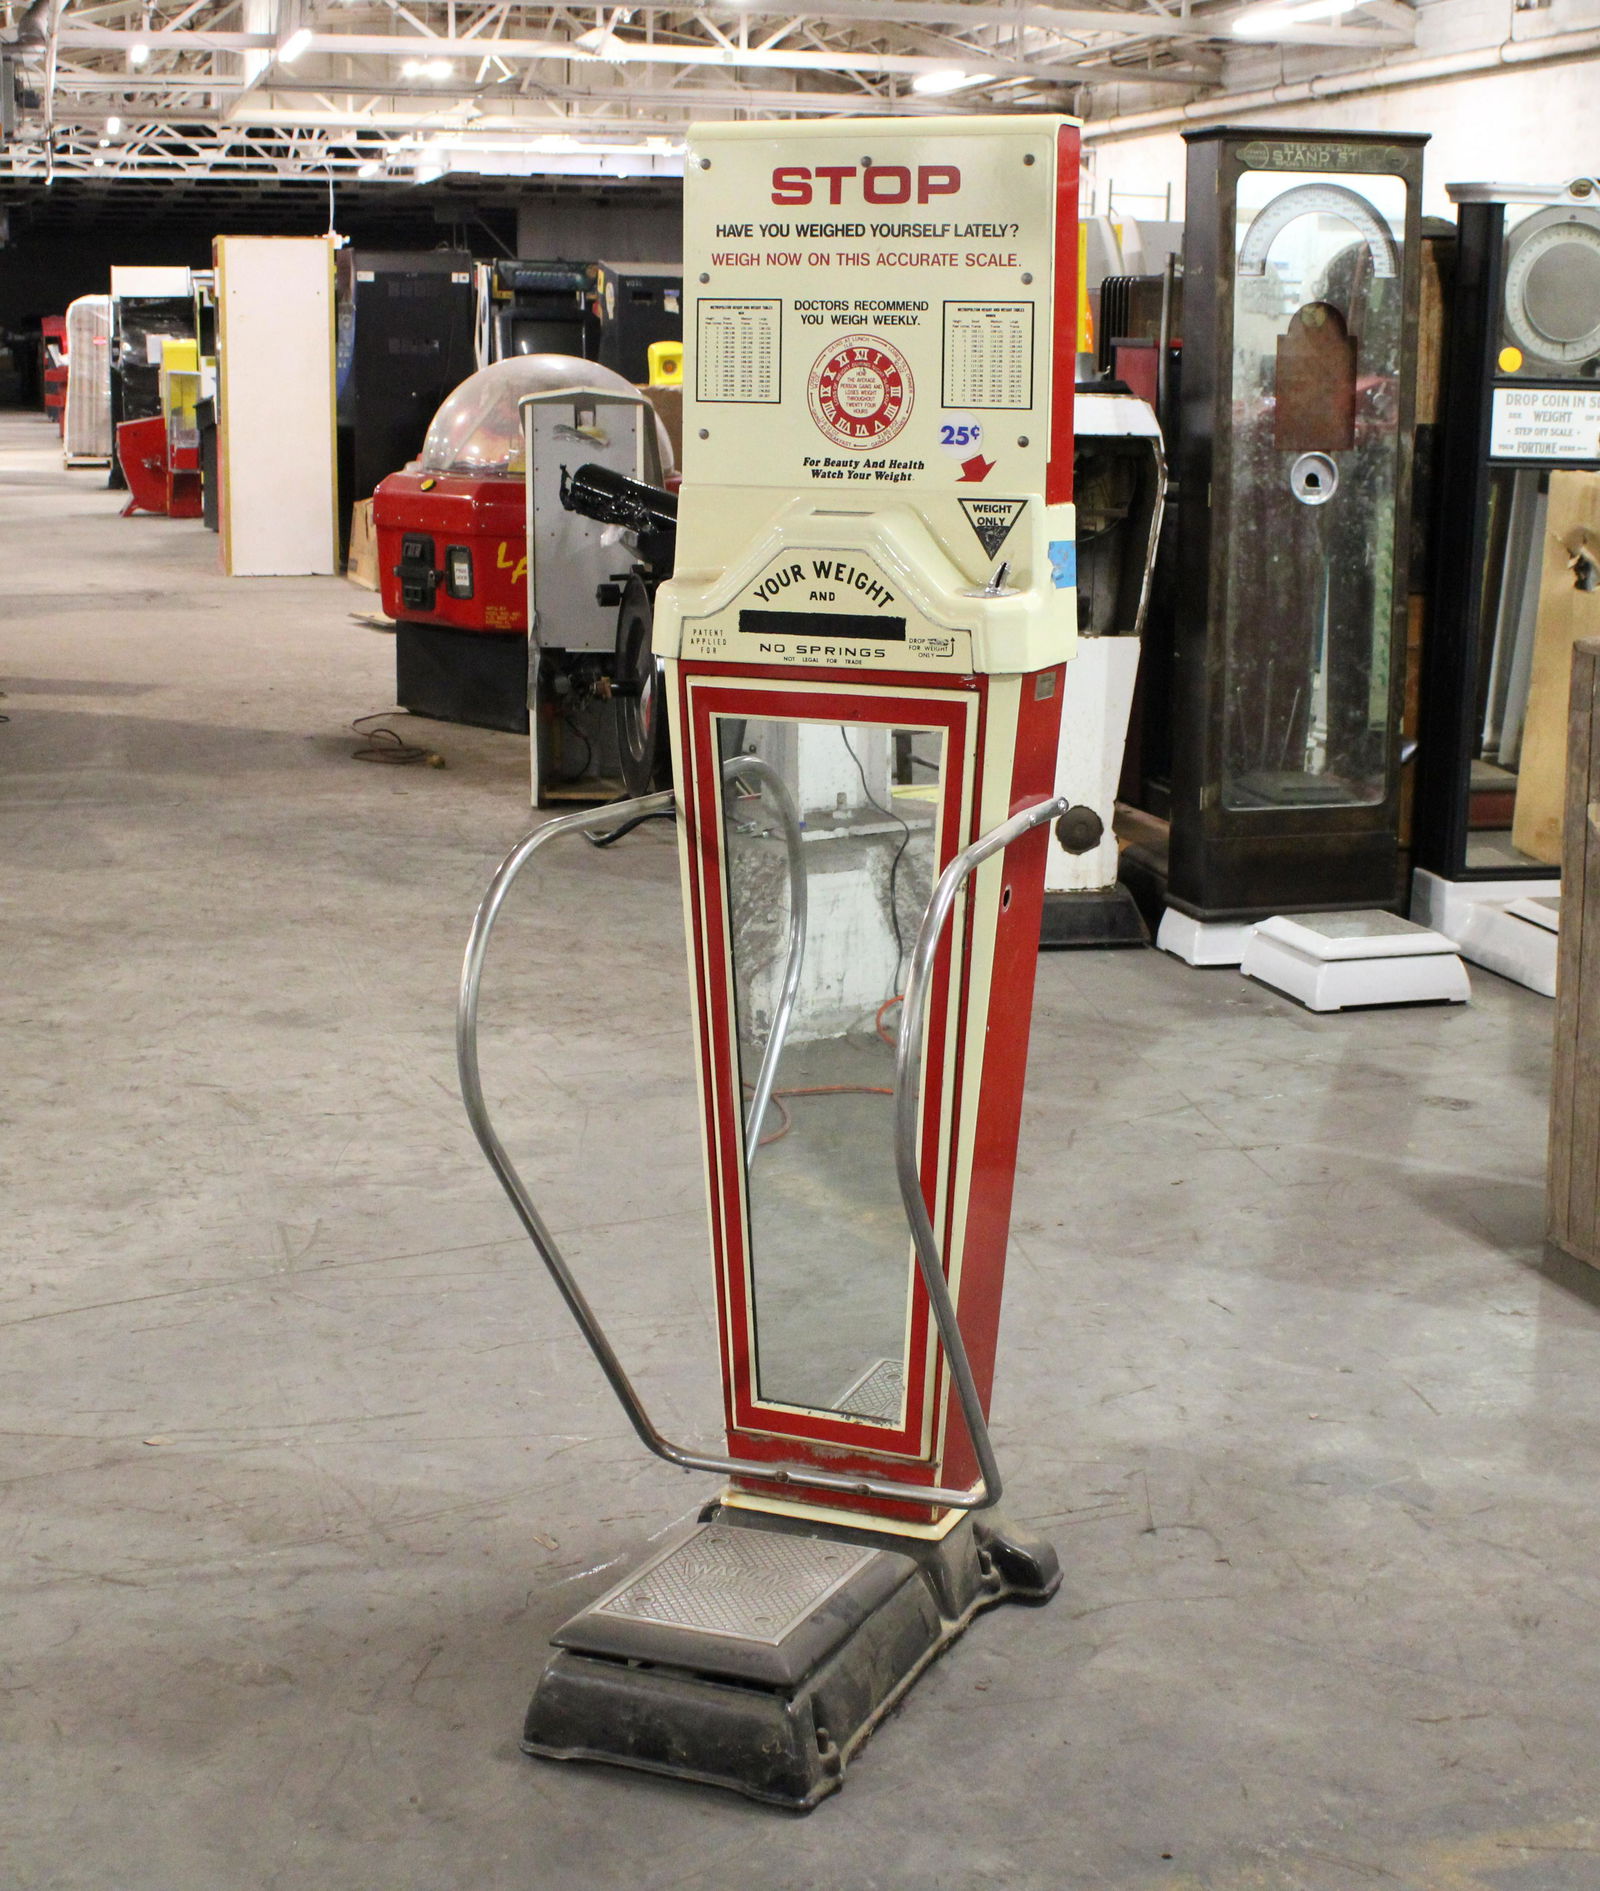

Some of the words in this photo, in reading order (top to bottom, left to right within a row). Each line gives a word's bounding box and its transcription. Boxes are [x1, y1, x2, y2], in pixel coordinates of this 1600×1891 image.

[1272, 151, 1329, 162] STAND
[771, 165, 961, 205] STOP
[716, 224, 753, 237] HAVE
[759, 224, 790, 237] YOU
[795, 224, 866, 237] WEIGHED
[871, 223, 950, 238] YOURSELF
[954, 224, 1019, 237] LATELY?
[712, 254, 760, 265] WEIGH
[766, 253, 802, 266] NOW
[808, 253, 830, 266] ON
[836, 253, 870, 266] THIS
[876, 253, 958, 266] ACCURATE
[965, 253, 1022, 267] SCALE.
[794, 300, 849, 310] DOCTORS
[854, 301, 928, 311] RECOMMEND
[801, 315, 824, 324] YOU
[831, 315, 868, 325] WEIGH
[873, 315, 920, 325] WEEKLY.
[835, 352, 850, 367] XI
[853, 349, 869, 360] XII
[824, 368, 836, 380] X
[884, 365, 896, 377] II
[822, 385, 831, 397] IX
[890, 386, 901, 397] III
[1506, 394, 1538, 405] DROP
[1542, 395, 1569, 407] COIN
[1573, 396, 1586, 407] IN
[1534, 411, 1572, 422] WEIGHT
[940, 424, 980, 446] 25¢
[1514, 427, 1532, 435] STEP
[1550, 428, 1573, 436] SCALE
[1517, 442, 1557, 453] FORTUNE
[803, 457, 821, 466] For
[823, 458, 860, 469] Beauty
[863, 459, 885, 468] And
[889, 460, 924, 469] Health
[811, 469, 843, 478] Watch
[847, 470, 871, 480] Your
[973, 504, 1012, 513] WEIGHT
[977, 517, 1005, 525] ONLY
[753, 564, 806, 602] YOUR
[813, 561, 894, 608] WEIGHT
[810, 592, 835, 601] AND
[760, 644, 785, 652] NO
[797, 645, 885, 657] SPRINGS
